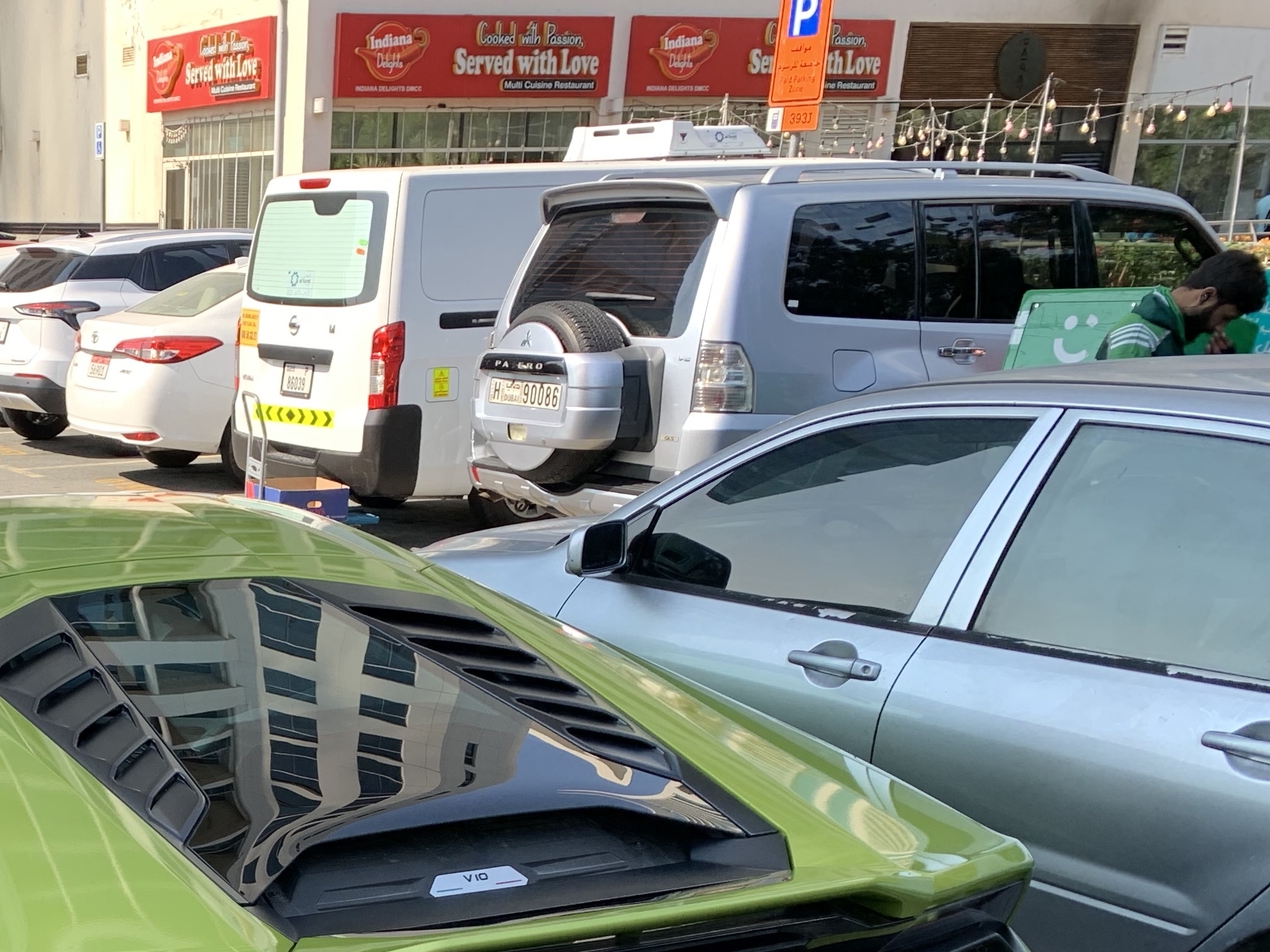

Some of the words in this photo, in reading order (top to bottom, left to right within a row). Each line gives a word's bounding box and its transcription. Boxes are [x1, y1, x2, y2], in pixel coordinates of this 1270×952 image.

[370, 33, 413, 50] Indiana
[480, 21, 516, 44] Cooked
[522, 21, 541, 44] with
[546, 22, 585, 47] Passion,
[664, 34, 703, 50] Indiana
[185, 57, 214, 86] Served
[215, 55, 237, 80] with
[237, 53, 258, 78] Love
[376, 52, 404, 74] Delights
[455, 47, 515, 75] Served
[516, 48, 558, 75] with
[560, 48, 600, 75] Love
[669, 52, 694, 74] Delights
[845, 49, 881, 75] Love
[504, 80, 523, 90] Multi
[524, 80, 553, 90] Cuisine
[554, 80, 595, 90] Restaurant
[837, 81, 875, 90] Restaurant
[790, 112, 813, 125] 393J
[286, 375, 307, 391] 86039
[493, 382, 502, 400] H
[523, 383, 559, 408] 90086
[504, 394, 520, 402] DUBAI
[463, 872, 489, 883] V10
